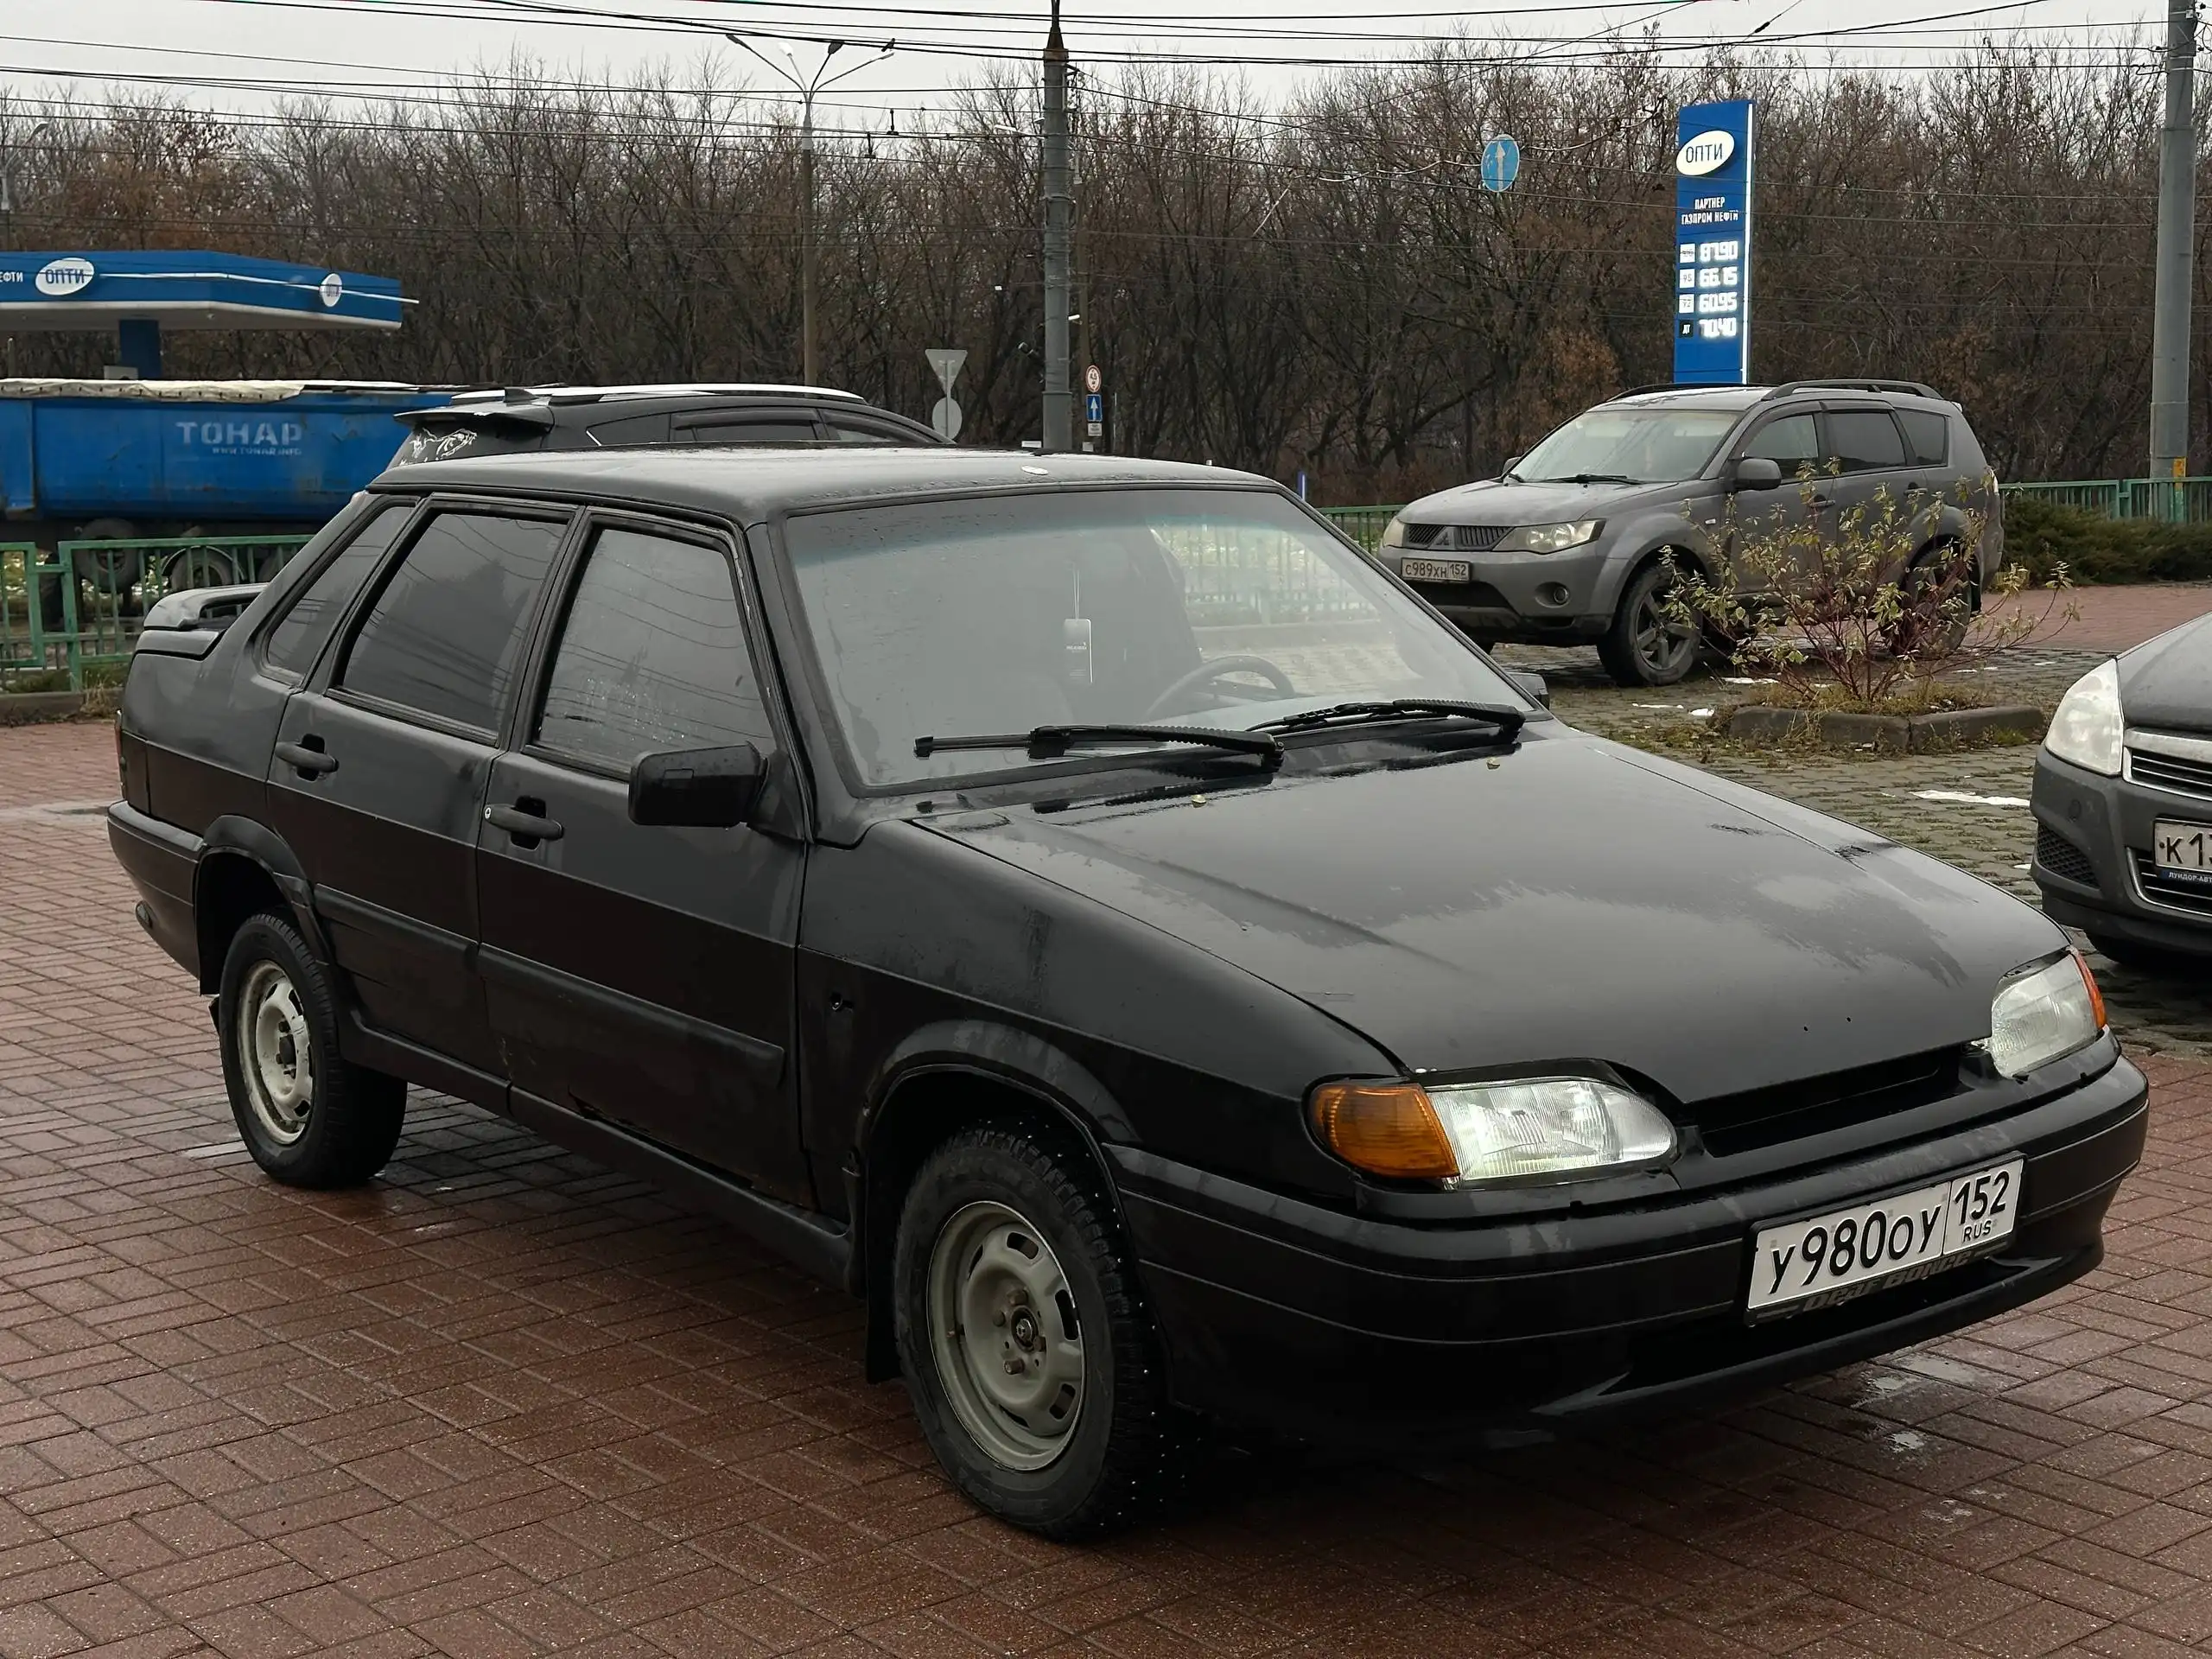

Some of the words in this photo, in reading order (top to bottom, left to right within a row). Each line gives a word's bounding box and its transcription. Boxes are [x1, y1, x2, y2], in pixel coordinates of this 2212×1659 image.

[1685, 143, 1723, 163] ОПТИ
[1694, 196, 1726, 210] ПАРТНЕР
[1681, 212, 1712, 225] ГАЗПРОМ
[1714, 209, 1738, 222] НЕФТИ
[45, 267, 85, 284] ОПТИ
[175, 422, 302, 445] ТОНАР
[1405, 562, 1447, 578] С989ХН
[1450, 564, 1466, 576] 152
[1768, 1205, 1942, 1294] У980ОУ
[1954, 1170, 2010, 1225] 152
[1962, 1219, 1992, 1243] RUS
